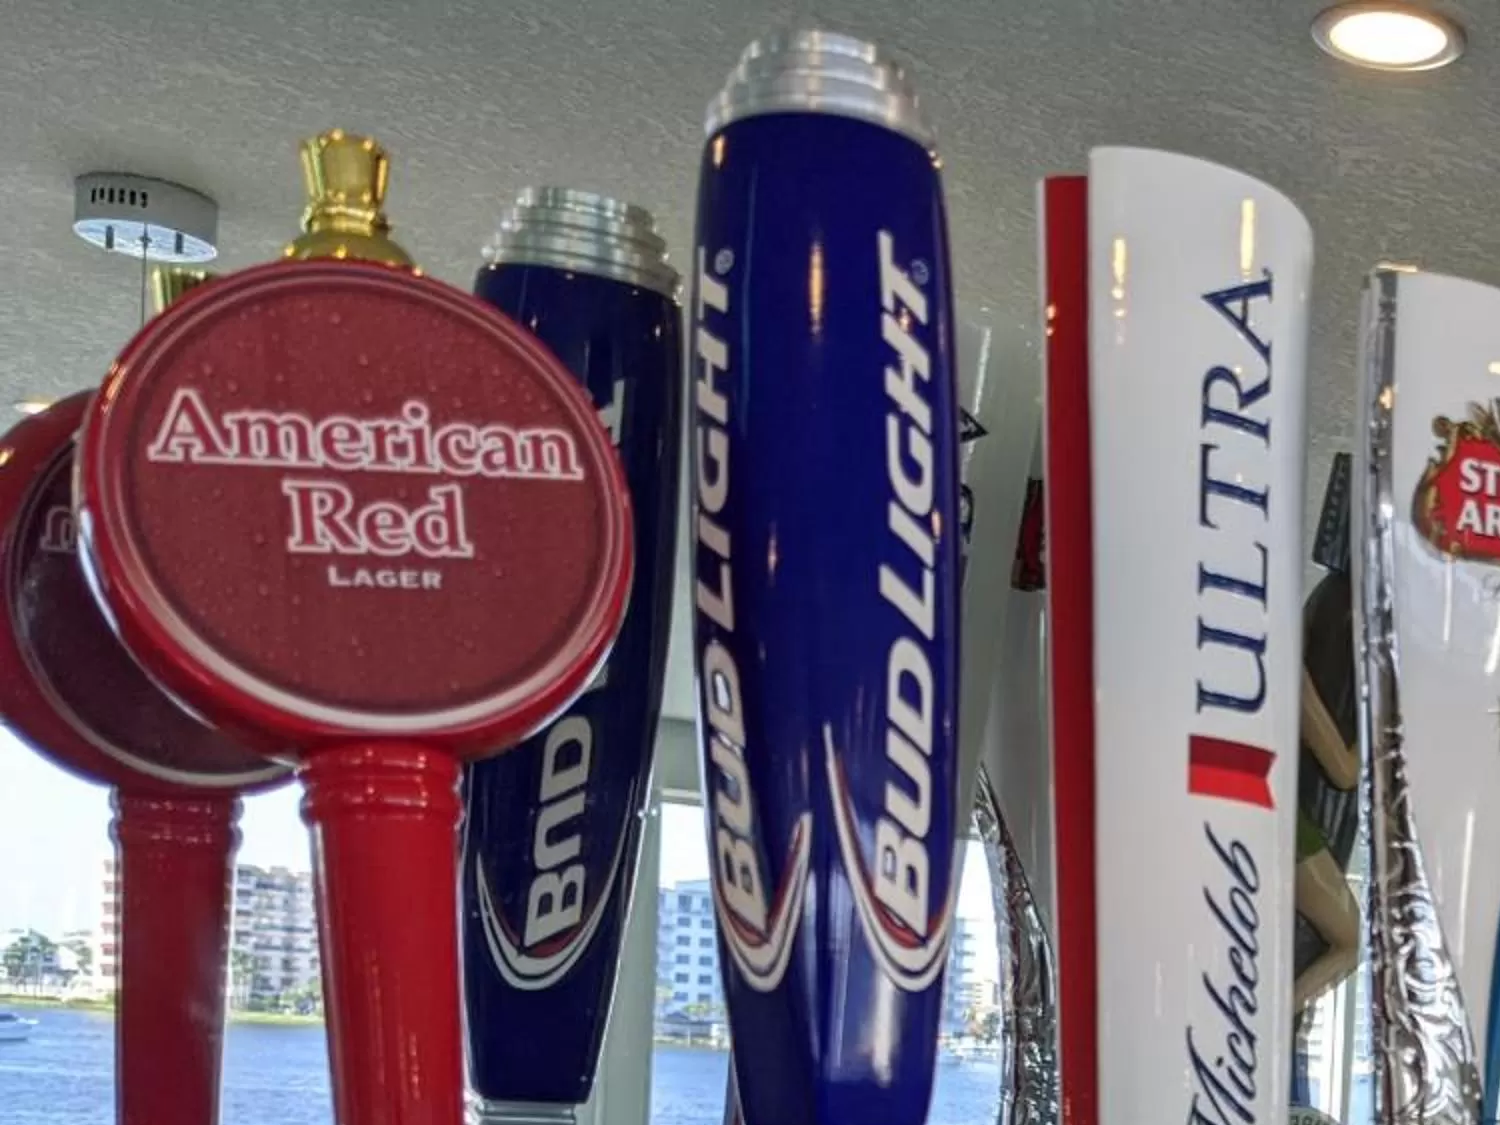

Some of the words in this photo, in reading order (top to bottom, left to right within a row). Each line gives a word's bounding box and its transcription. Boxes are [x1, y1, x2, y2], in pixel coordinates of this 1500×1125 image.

[147, 387, 585, 480] American
[282, 480, 474, 560] Red
[326, 565, 442, 591] LAGER
[696, 247, 735, 633] LIGHT
[876, 229, 935, 640] LIGHT
[1195, 267, 1275, 716] ULTRA
[704, 641, 768, 935] BUD
[873, 636, 935, 938] BUD
